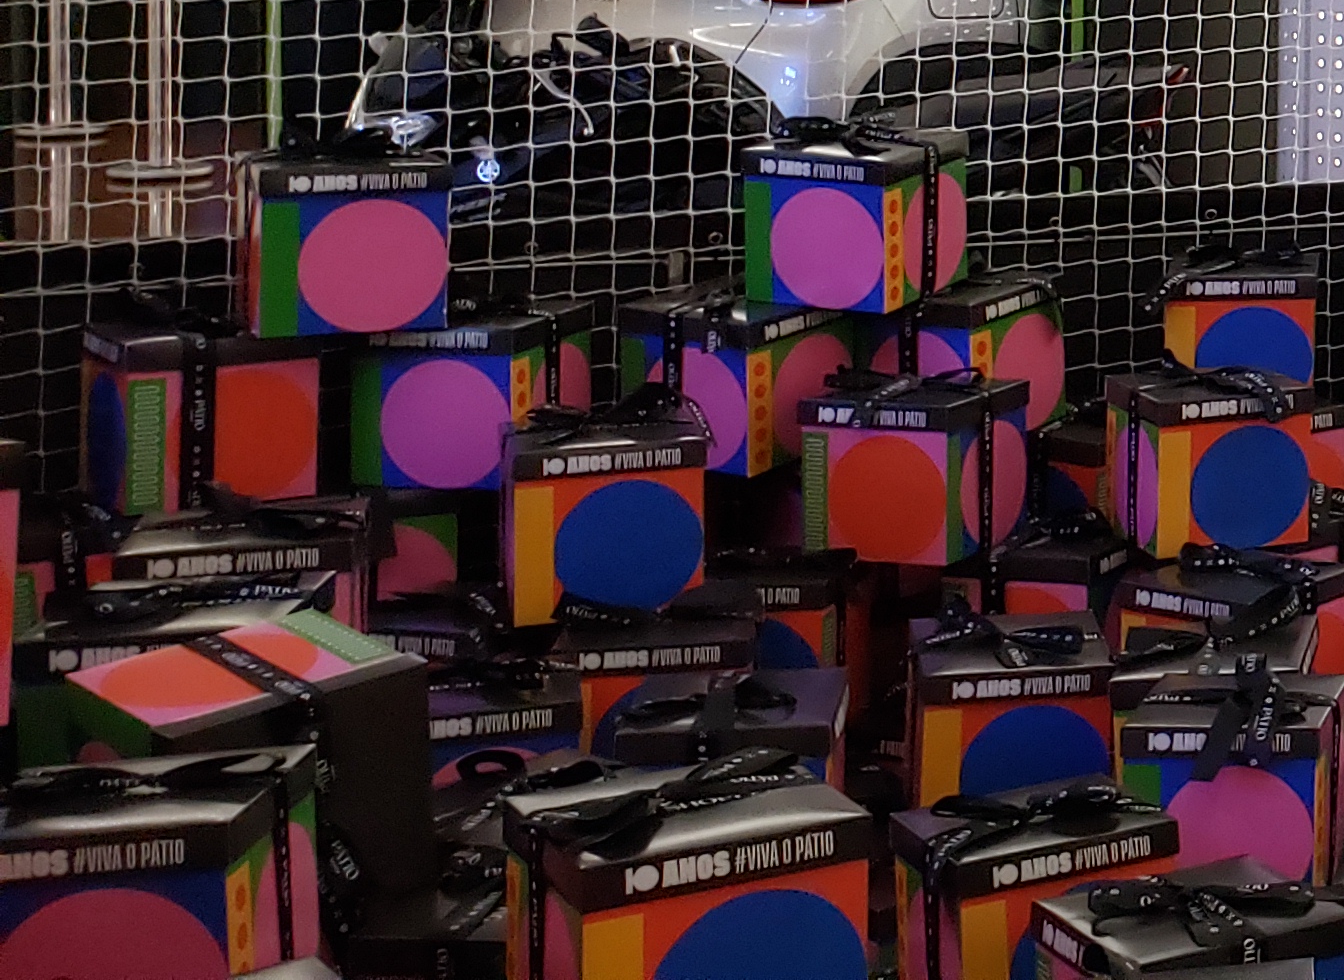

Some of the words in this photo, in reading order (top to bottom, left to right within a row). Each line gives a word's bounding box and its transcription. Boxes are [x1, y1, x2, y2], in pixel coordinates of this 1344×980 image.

[818, 406, 835, 422] 10
[1182, 403, 1200, 420] 10
[1201, 400, 1238, 418] ANOS
[543, 457, 565, 477] 10
[568, 453, 612, 475] ANOS
[148, 559, 176, 579] 10
[178, 554, 234, 577] ANOS
[49, 649, 80, 672] 10
[579, 651, 602, 670] 10
[604, 649, 649, 669] ANOS
[952, 681, 975, 700] 10
[977, 678, 1021, 698] ANOS
[474, 714, 509, 735] #VIVA
[512, 714, 519, 731] O
[1148, 732, 1170, 752] 10
[74, 845, 124, 875] #VIVA
[126, 844, 136, 869] O
[140, 837, 184, 867] PÁTIO
[626, 861, 659, 895] 10
[663, 849, 730, 888] ANOS
[735, 840, 779, 874] #VIVA
[784, 838, 792, 865] O
[795, 828, 834, 863] PÁTIO
[993, 861, 1019, 888] 10
[1021, 851, 1072, 882] ANOS
[1076, 844, 1109, 872] #VIVA
[1113, 842, 1119, 864] O
[1122, 833, 1151, 863] PÁTIO
